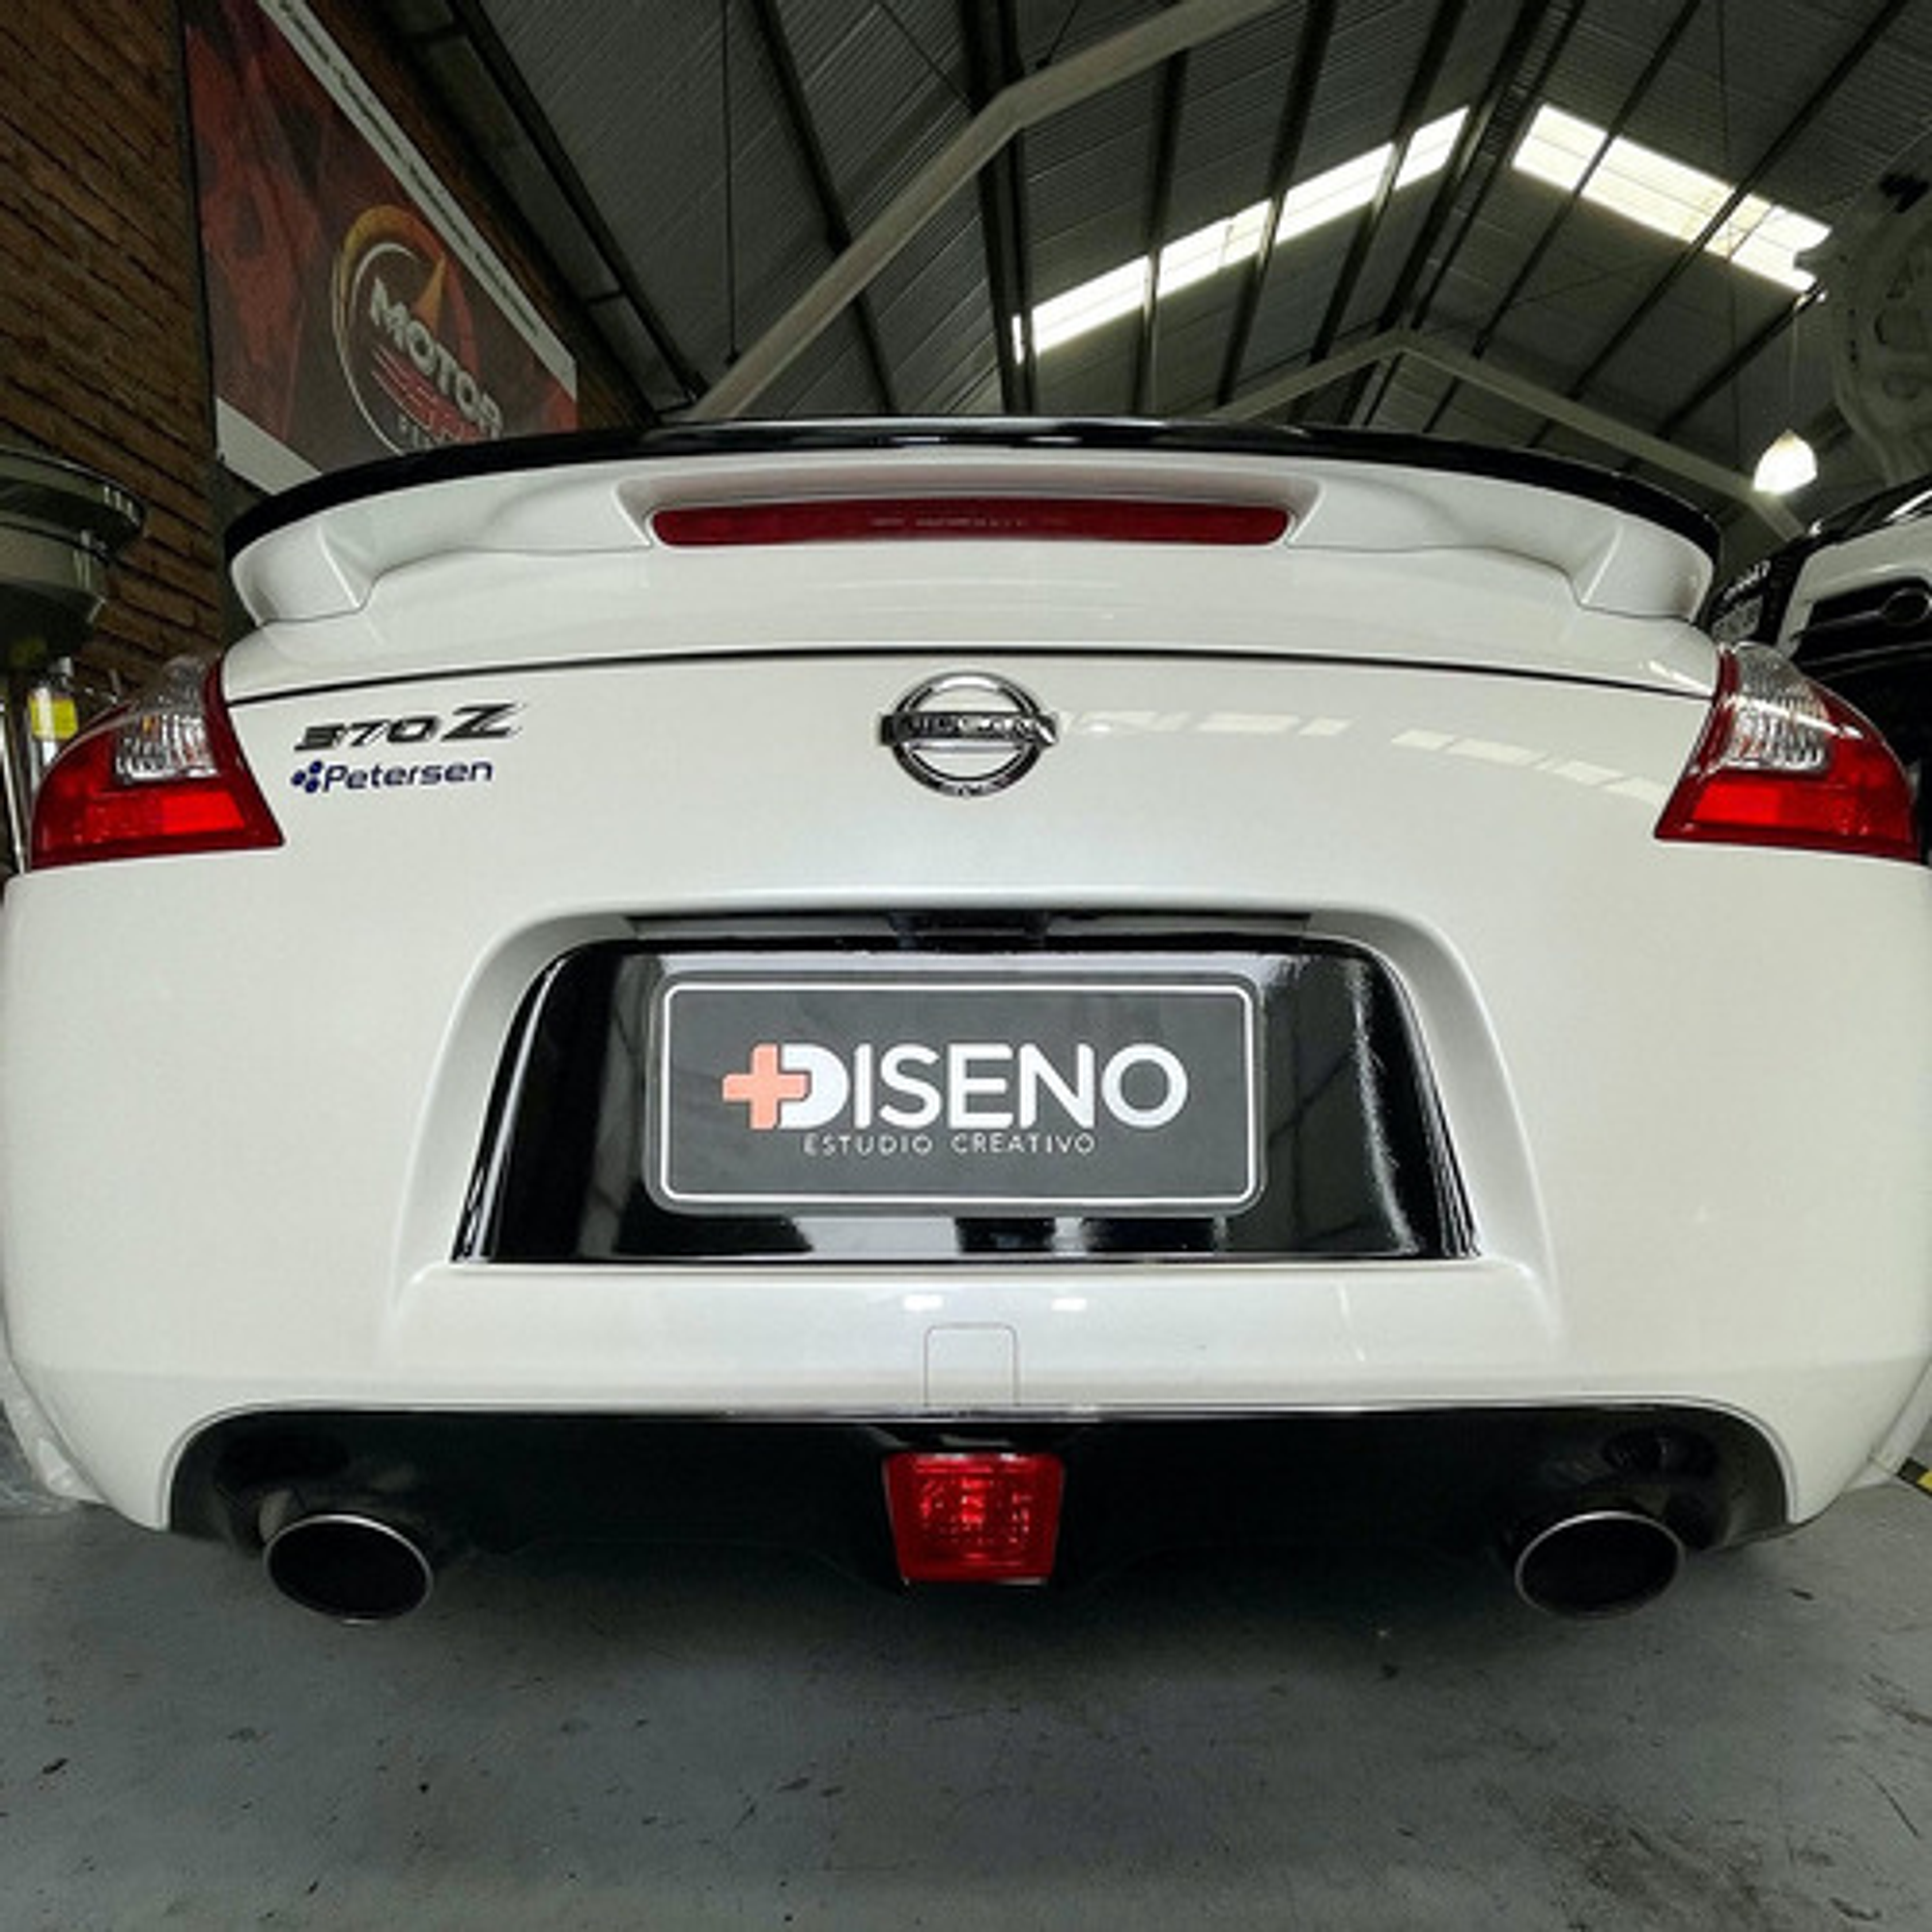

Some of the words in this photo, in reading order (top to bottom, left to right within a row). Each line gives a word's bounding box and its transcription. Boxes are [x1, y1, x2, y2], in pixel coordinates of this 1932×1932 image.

[368, 275, 503, 440] MOTOR
[323, 760, 494, 793] Petersen
[803, 1133, 933, 1156] ESTUDIO
[951, 1131, 1094, 1154] CREATIVO
